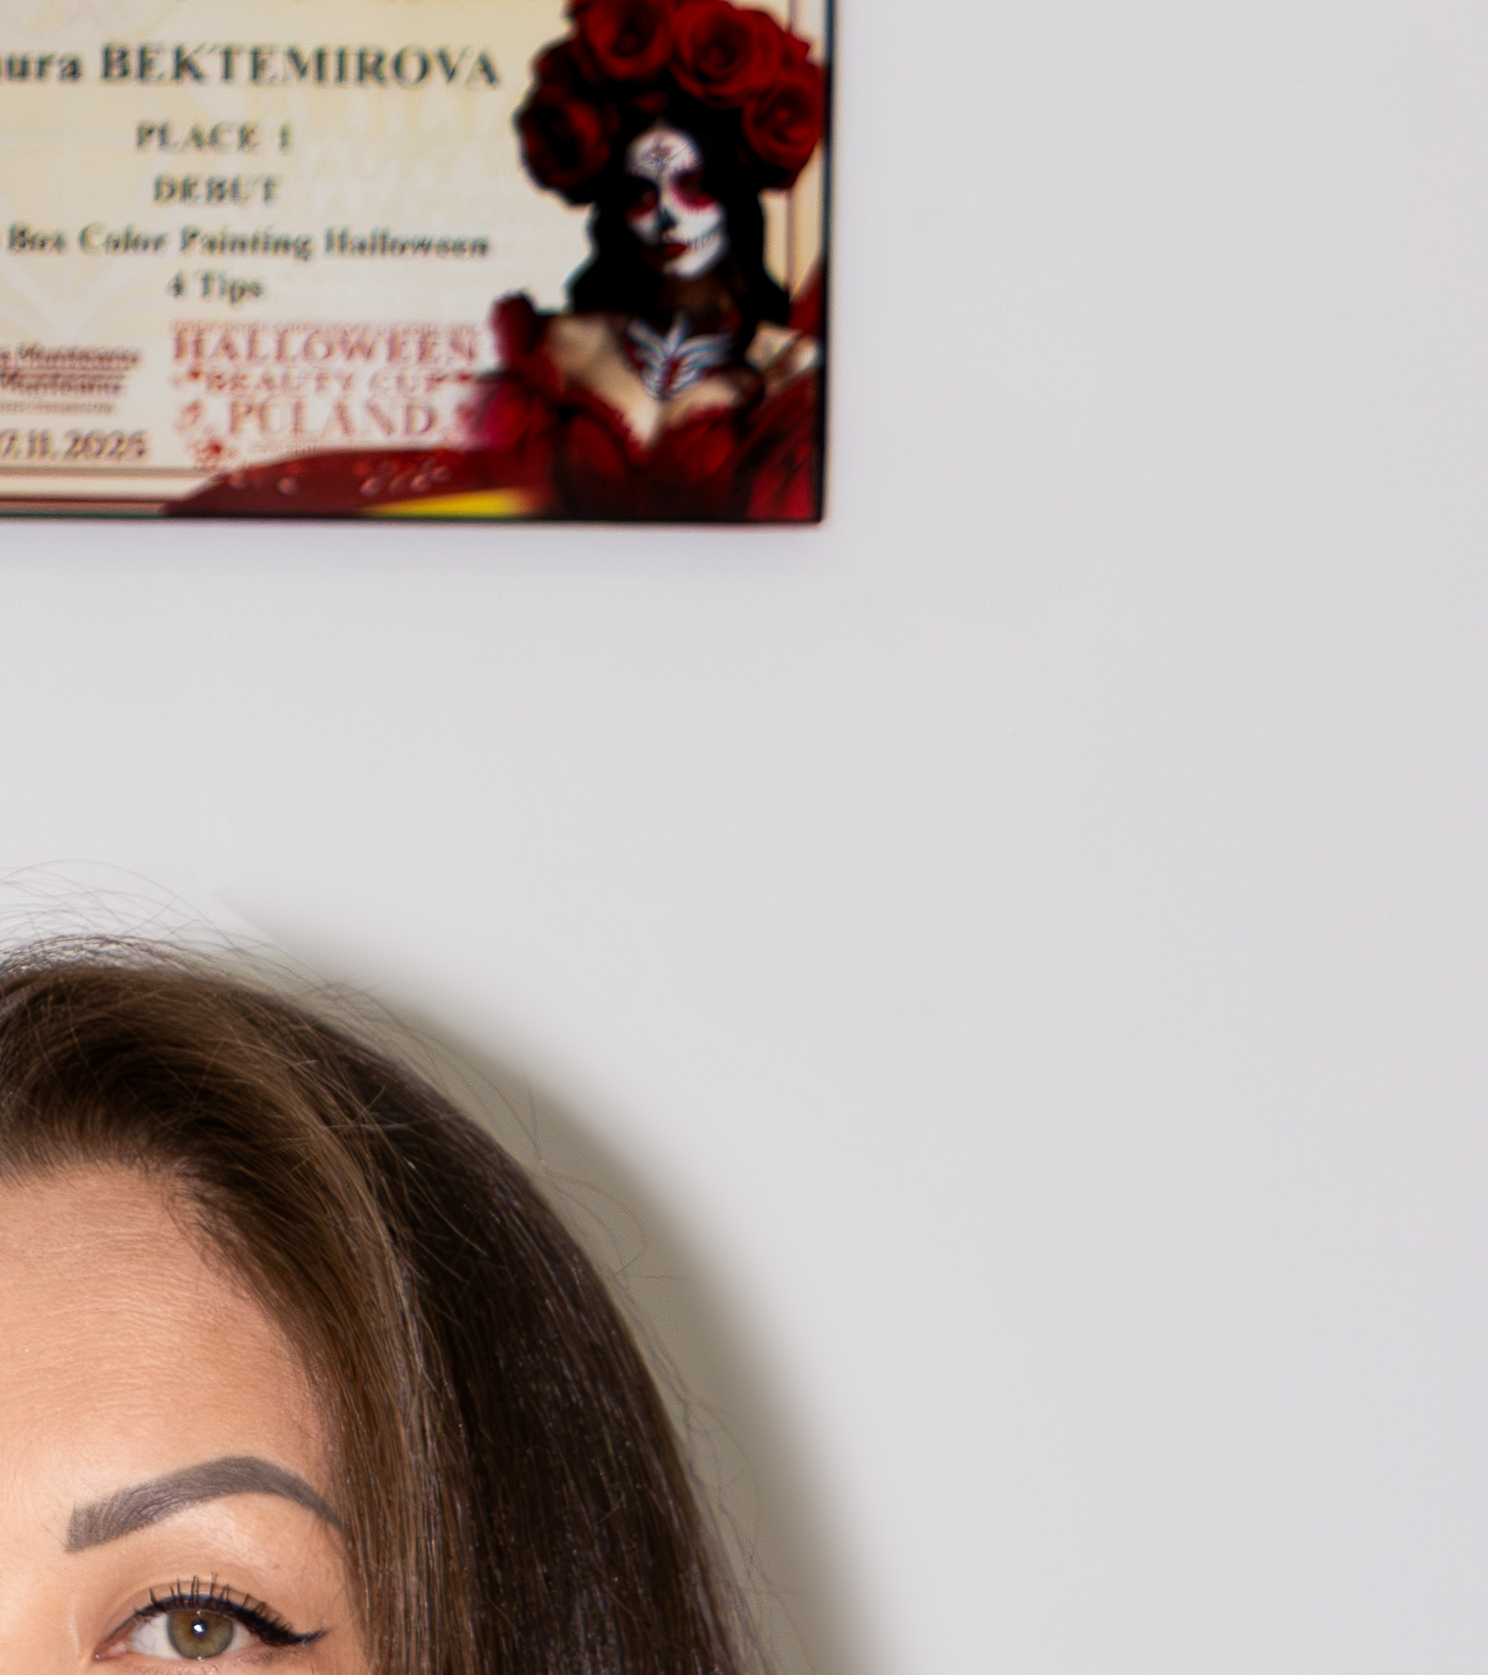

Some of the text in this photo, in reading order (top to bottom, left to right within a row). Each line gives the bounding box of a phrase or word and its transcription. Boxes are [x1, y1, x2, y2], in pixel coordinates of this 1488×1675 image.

[100, 42, 501, 88] BEKTEMIROVA
[135, 121, 259, 152] PLACE
[153, 175, 279, 206] DEBUT
[7, 225, 66, 254] Box
[79, 224, 168, 255] Color
[179, 226, 313, 262] Painting
[324, 226, 491, 259] Halloween
[169, 271, 265, 306] 4 Tips
[173, 325, 477, 363] HALLOWEEN
